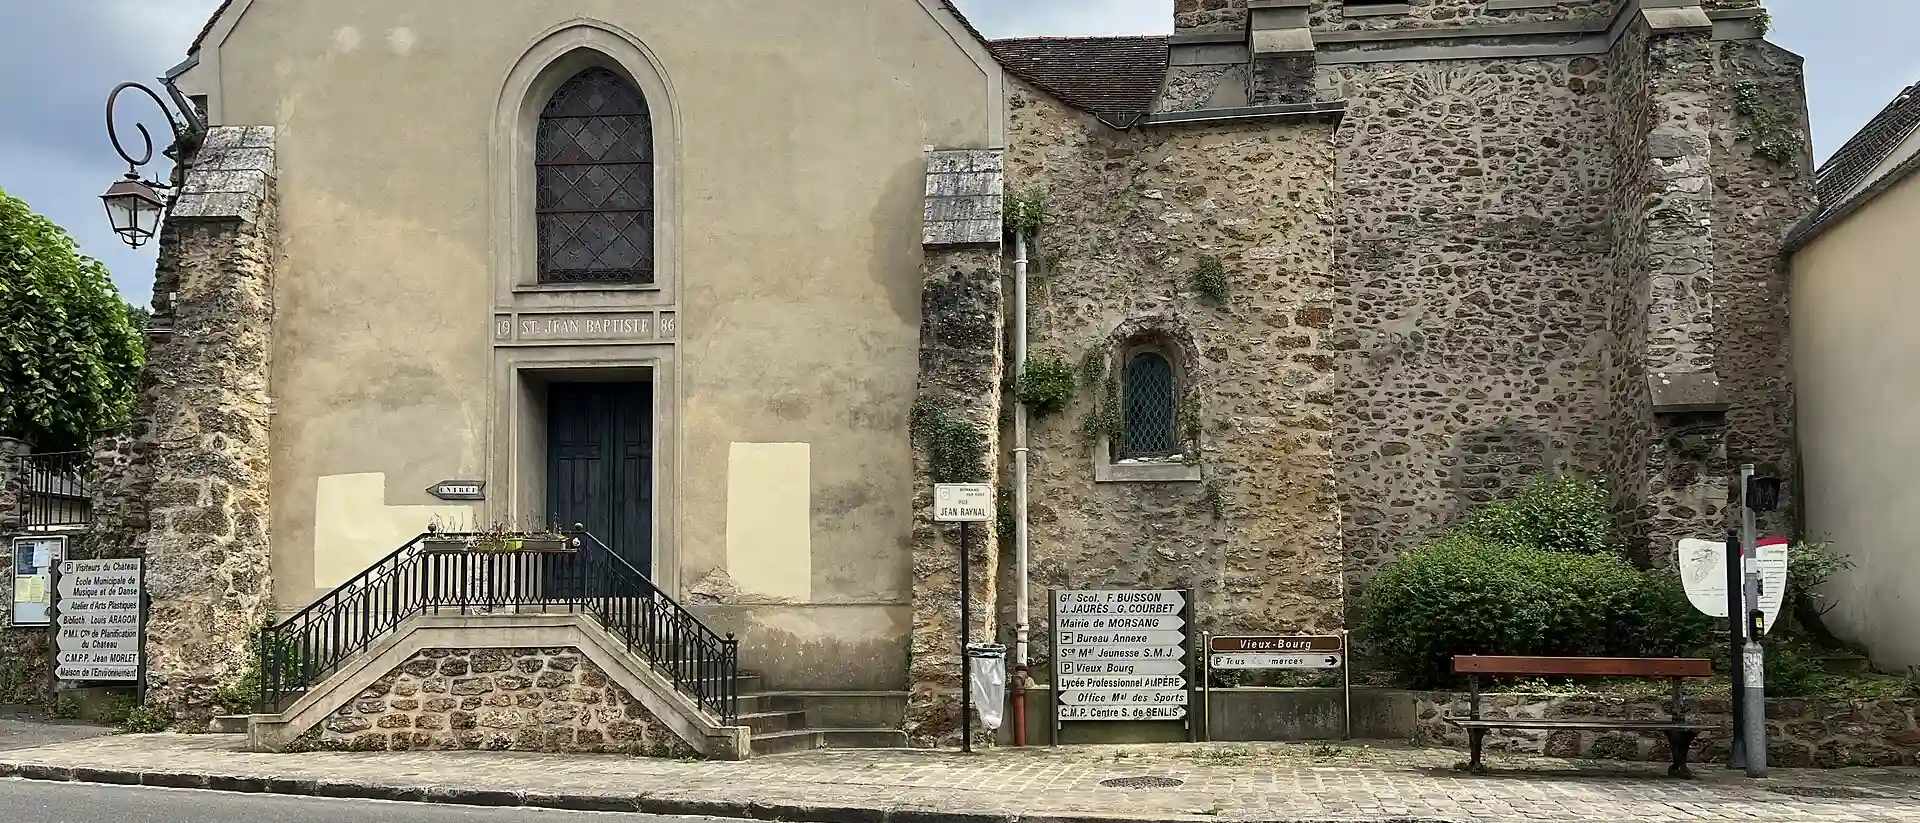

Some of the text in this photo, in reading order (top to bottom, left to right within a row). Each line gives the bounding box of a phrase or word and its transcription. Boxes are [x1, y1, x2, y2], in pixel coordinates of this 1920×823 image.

[497, 320, 510, 336] 19
[544, 319, 580, 334] JEAN
[586, 318, 649, 333] BAPTISTE
[660, 318, 675, 332] 86
[940, 508, 986, 516] JEAN RAYNAL
[76, 562, 100, 572] Visiteurs
[103, 562, 110, 571] du
[76, 576, 136, 586] École Municipale de
[73, 588, 98, 598] Musique
[108, 587, 116, 595] de
[118, 587, 137, 595] Danse
[1076, 593, 1100, 602] Scol.
[1106, 594, 1114, 602] F.
[1117, 593, 1161, 602] BUISSON
[71, 601, 136, 611] Atelier d'Arts Plastiques
[1060, 604, 1068, 613] J.
[1070, 603, 1109, 613] JAURÈS
[1117, 604, 1126, 613] G.
[1128, 604, 1174, 613] COURBET
[90, 616, 106, 624] Louis
[108, 615, 137, 623] ARAGON
[1060, 619, 1159, 627] Mairie de MORSANG
[92, 629, 98, 638] de
[101, 629, 136, 638] Planification
[1076, 634, 1148, 642] Bureau Annexe
[1240, 639, 1312, 650] Vieux-Bourg
[93, 653, 107, 662] Jean
[110, 654, 136, 662] MORLET
[1098, 648, 1139, 657] Jeunesse
[1144, 648, 1174, 657] S.M.J.
[60, 668, 80, 676] Maison
[82, 668, 89, 676] de
[1076, 664, 1102, 672] Vieux
[1106, 664, 1134, 674] Bourg
[1061, 678, 1084, 689] Lycée
[1087, 678, 1142, 687] Professionnel
[1078, 693, 1106, 702] Office
[1132, 693, 1148, 702] des
[1154, 693, 1184, 703] Sports
[1061, 708, 1178, 717] C.M.P. Centre S. de SENLIS
